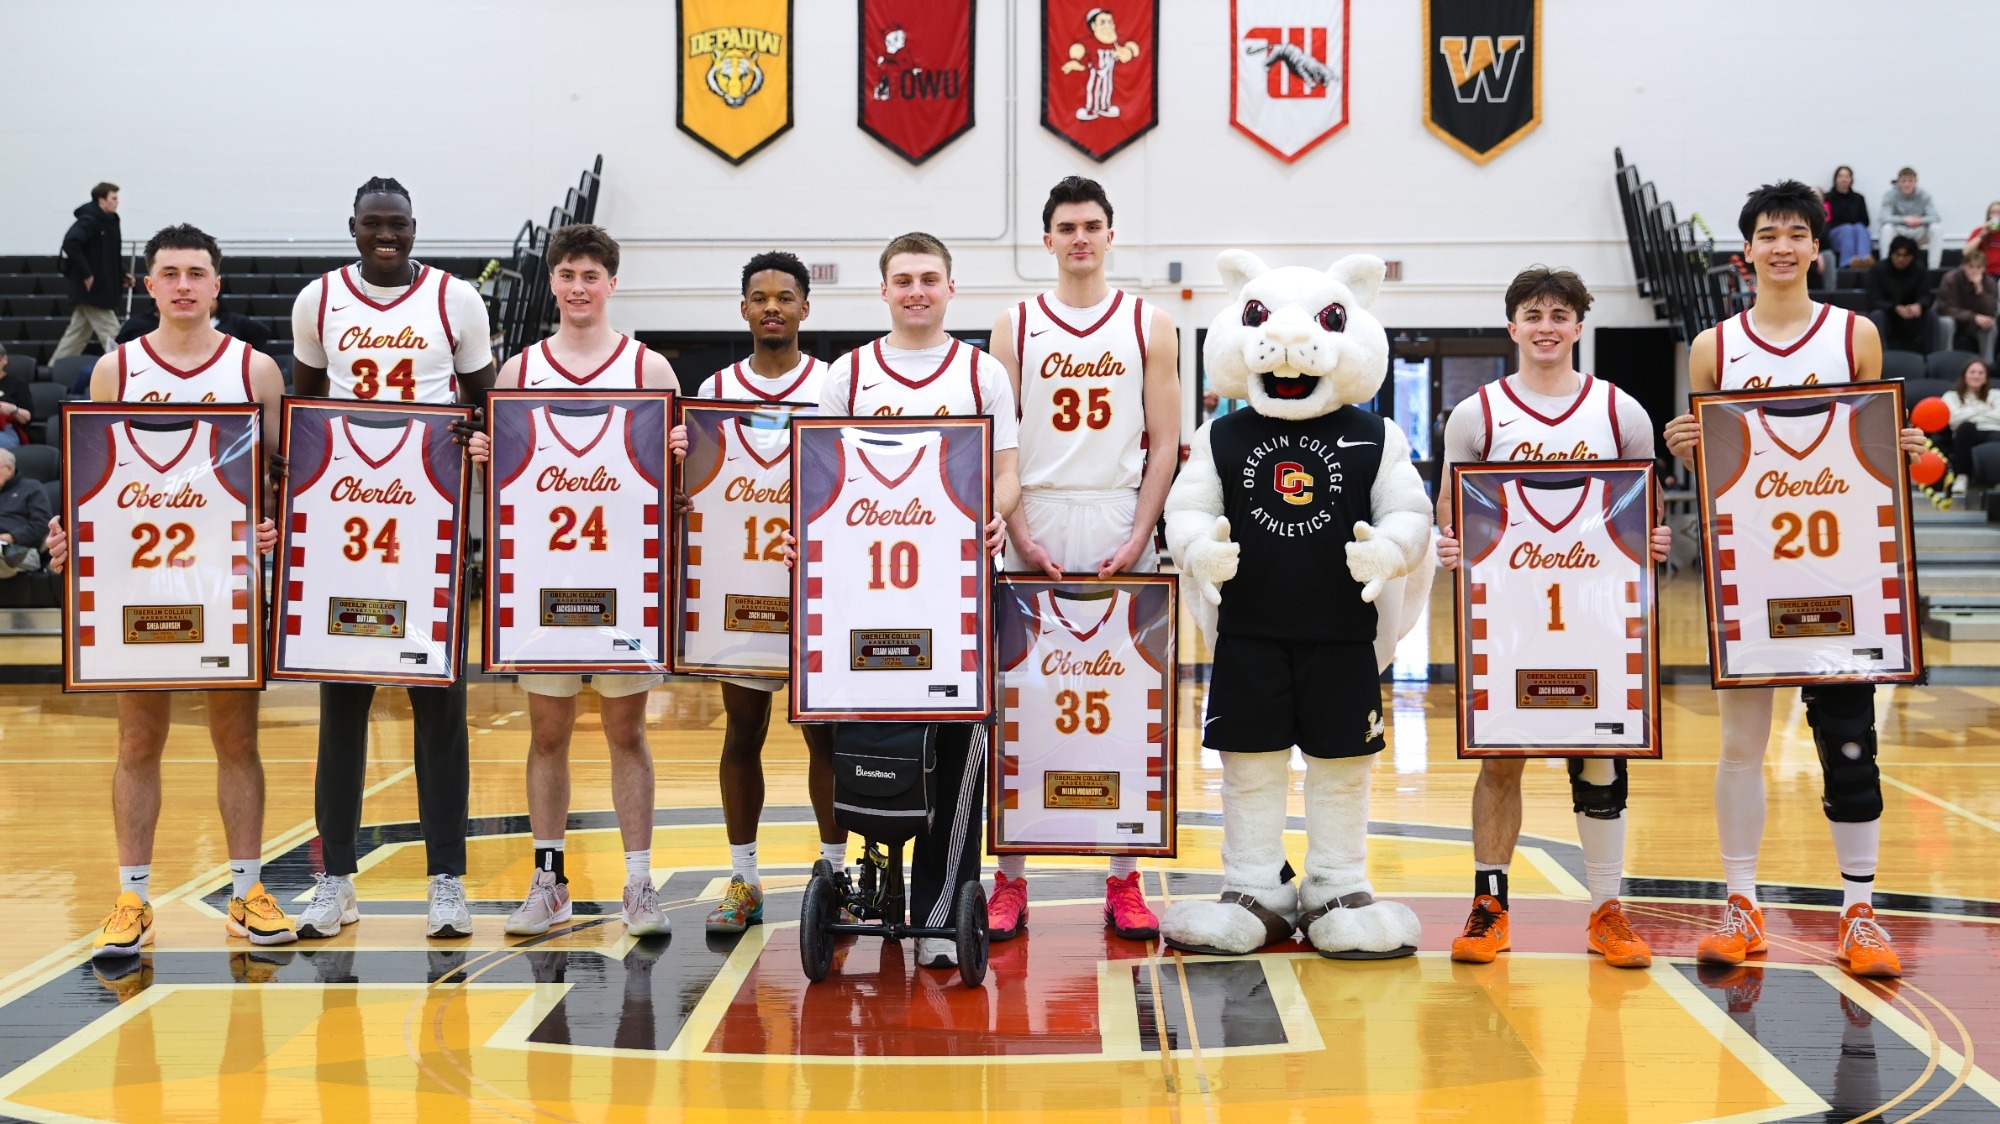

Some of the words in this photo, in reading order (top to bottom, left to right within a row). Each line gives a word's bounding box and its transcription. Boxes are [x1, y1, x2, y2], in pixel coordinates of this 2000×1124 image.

[690, 27, 781, 58] DEPAUW
[901, 68, 959, 99] OWU
[1440, 35, 1525, 103] W
[811, 264, 835, 280] EXIT
[338, 326, 428, 351] Oberlin
[351, 358, 416, 402] 34
[1041, 351, 1126, 379] Oberlin
[1052, 386, 1112, 432] 35
[536, 465, 621, 492] Oberlin
[1243, 435, 1289, 488] OBERLIN
[1299, 435, 1343, 494] COLLEGE
[117, 482, 207, 509] Oberlin
[330, 476, 417, 505] Oberlin
[724, 476, 791, 504] Oberl
[1755, 466, 1850, 499] Oberlin
[846, 497, 936, 527] Oberlin
[1250, 507, 1331, 537] ATHLETICS
[342, 516, 401, 565] 34
[548, 505, 608, 552] 24
[743, 515, 791, 562] 12
[1771, 509, 1840, 560] 20
[131, 522, 197, 569] 22
[1509, 541, 1600, 570] Oberlin
[868, 540, 920, 590] 10
[1546, 582, 1565, 631] 1
[1041, 649, 1126, 676] Oberlin
[1055, 688, 1112, 735] 35
